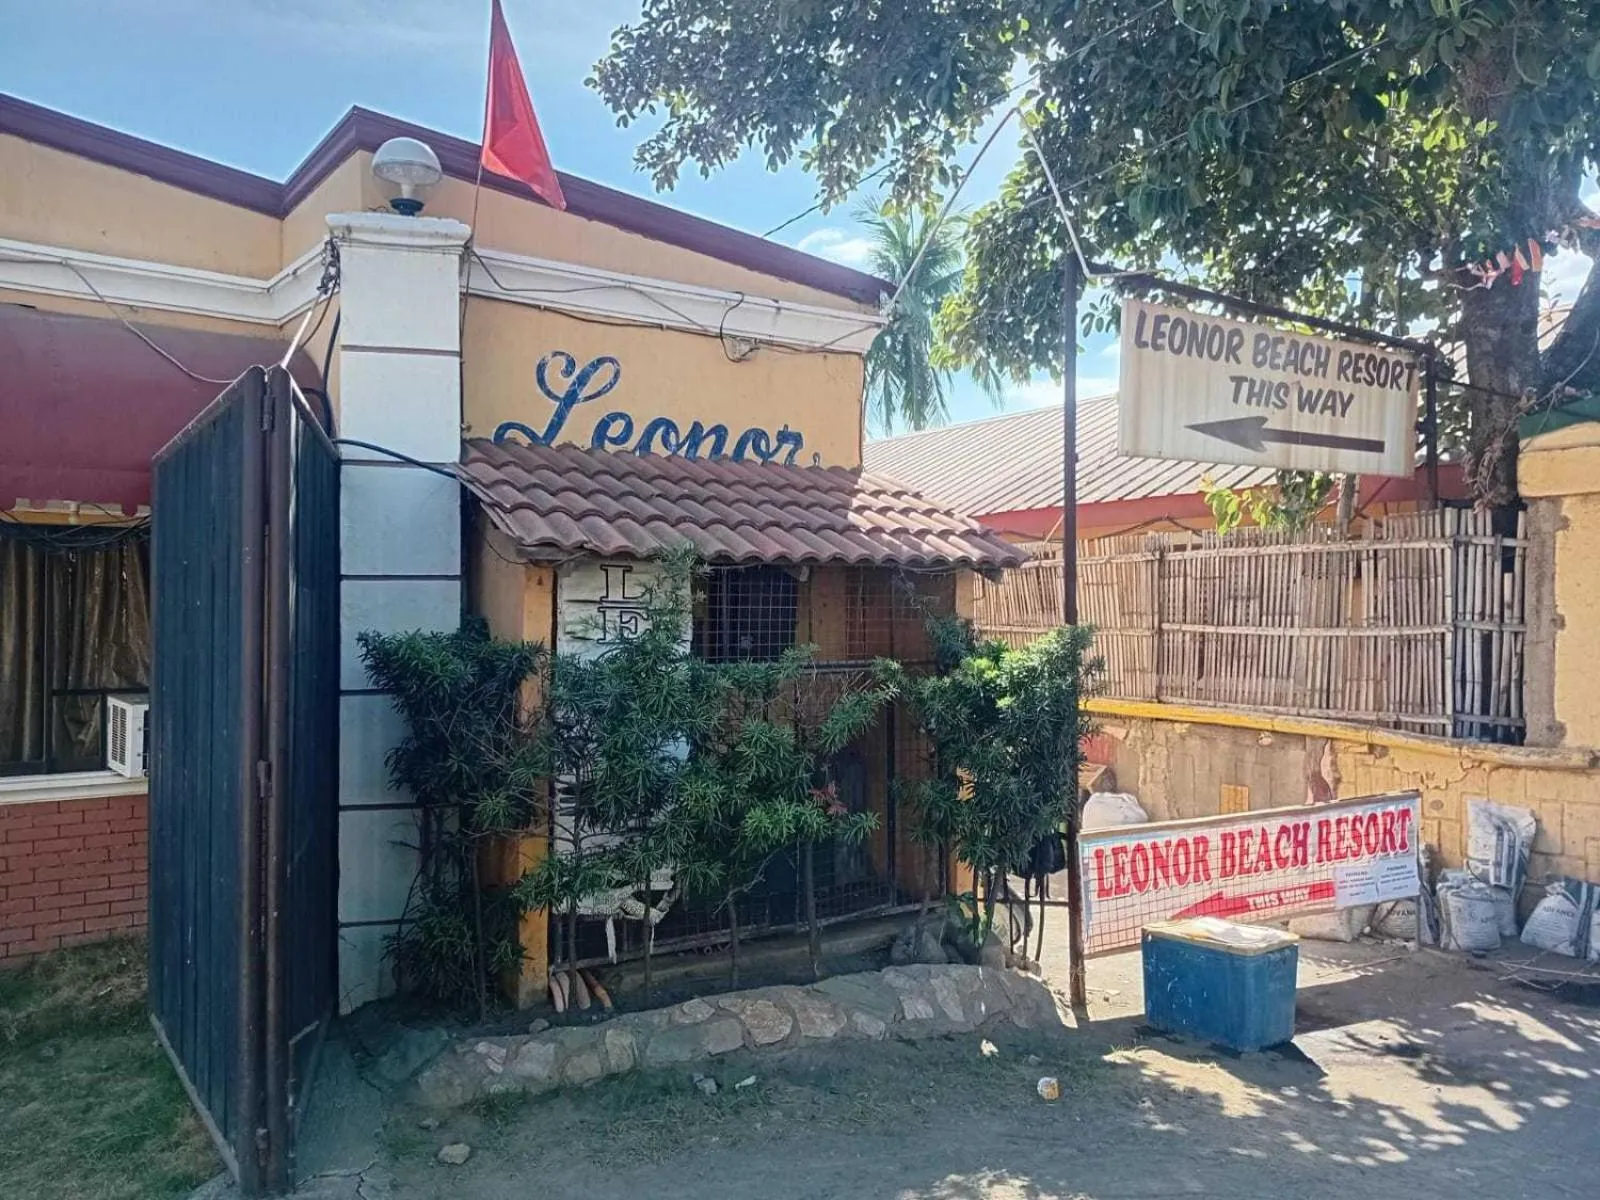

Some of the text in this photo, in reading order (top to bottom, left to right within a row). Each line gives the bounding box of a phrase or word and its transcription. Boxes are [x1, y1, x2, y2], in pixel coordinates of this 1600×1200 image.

[1134, 309, 1418, 392] LEONOR BEACH RESORT
[492, 350, 805, 466] Leonor
[1229, 376, 1355, 418] THIS WAY
[1094, 835, 1213, 900] LEONOR
[1219, 821, 1312, 879] BEACH
[1315, 807, 1414, 864] RESORT
[1246, 887, 1311, 911] THIS WAY
